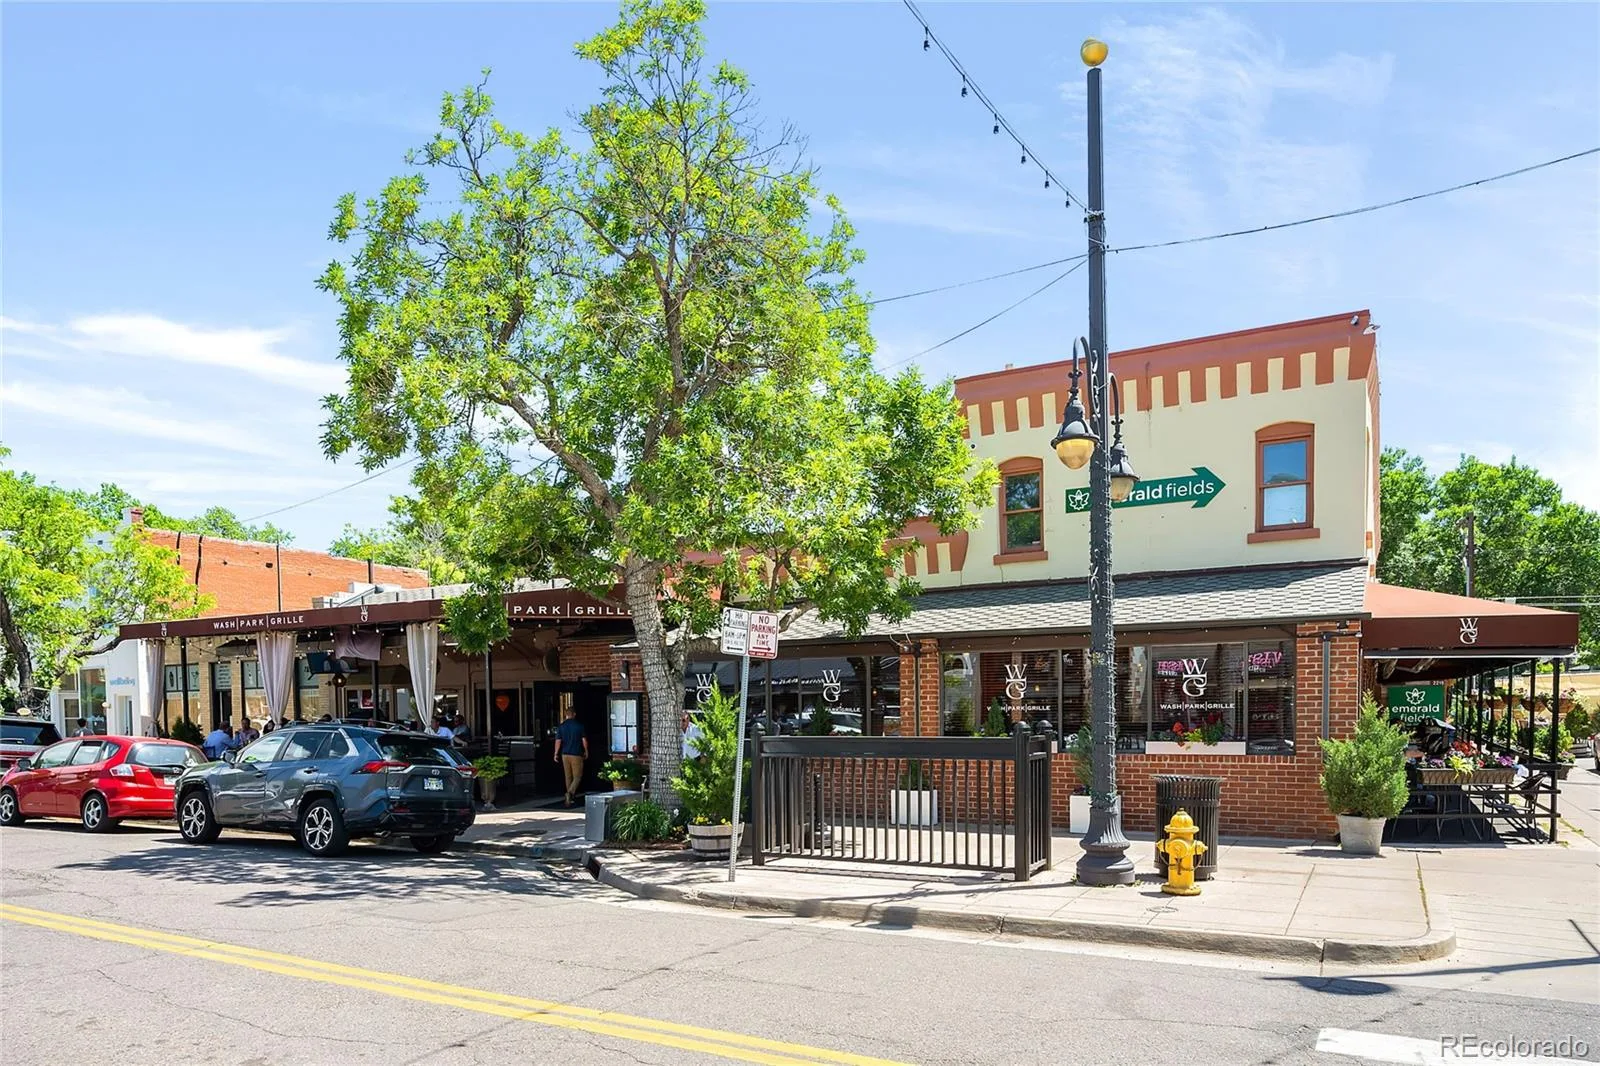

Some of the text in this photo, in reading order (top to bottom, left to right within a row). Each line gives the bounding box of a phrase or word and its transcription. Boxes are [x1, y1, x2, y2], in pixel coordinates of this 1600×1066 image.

[1166, 480, 1215, 498] fields
[513, 606, 561, 615] PARK
[213, 615, 305, 630] WASH PARK GRILLE
[758, 616, 770, 625] NO
[751, 624, 775, 635] PARKING
[1184, 702, 1205, 710] PARK
[1391, 704, 1440, 713] emerald
[1399, 713, 1436, 722] field
